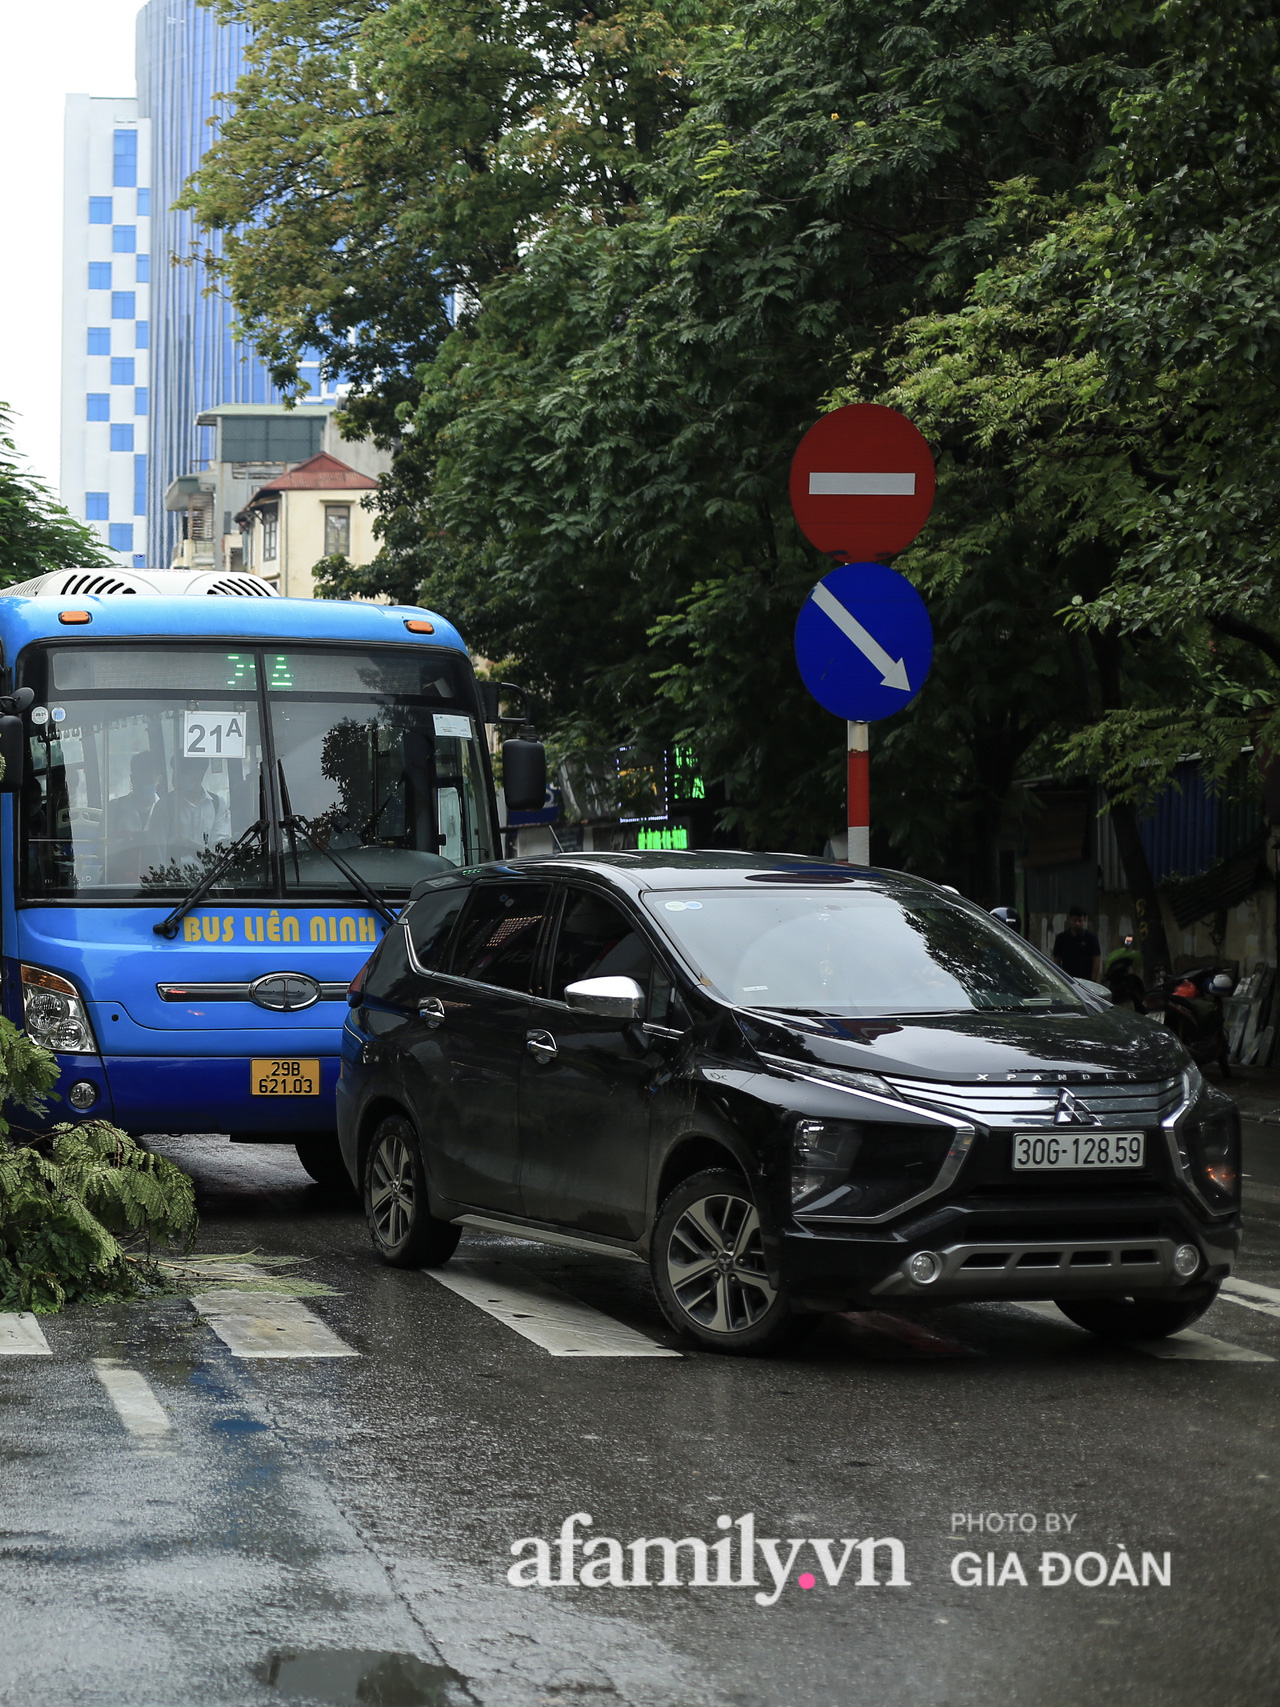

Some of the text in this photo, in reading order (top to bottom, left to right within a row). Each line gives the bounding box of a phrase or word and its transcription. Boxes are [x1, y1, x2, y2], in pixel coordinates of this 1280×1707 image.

[187, 718, 243, 753] 21A
[184, 909, 376, 943] BUS LIÊN NINH
[271, 1061, 300, 1076] 29B
[976, 1072, 1138, 1081] XPANDER
[259, 1078, 313, 1093] 621.03
[1017, 1136, 1141, 1165] 30G-128.59
